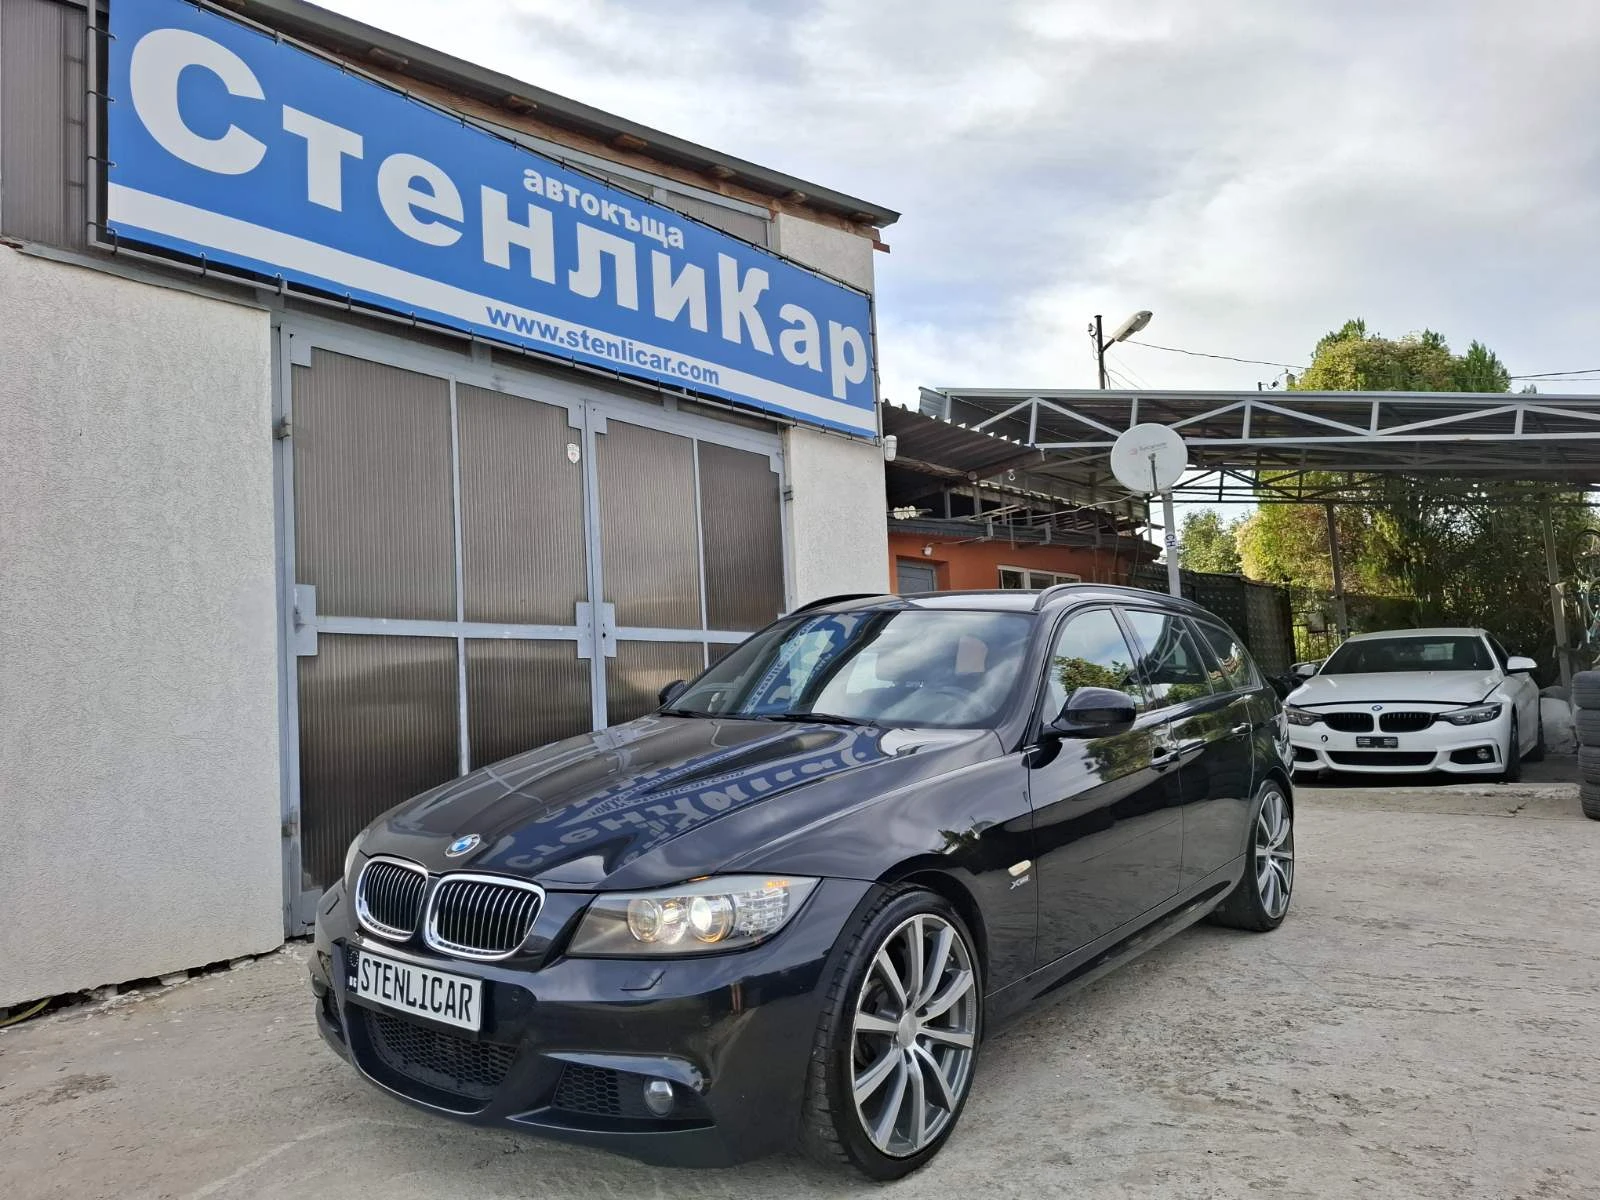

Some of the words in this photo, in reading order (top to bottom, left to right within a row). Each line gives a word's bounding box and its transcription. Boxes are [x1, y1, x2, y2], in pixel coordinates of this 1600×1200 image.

[130, 28, 869, 399] СтенлиКар
[523, 168, 684, 250] автокъща
[486, 306, 719, 385] www.stenlicar.com
[362, 958, 473, 1022] STENLICAR
